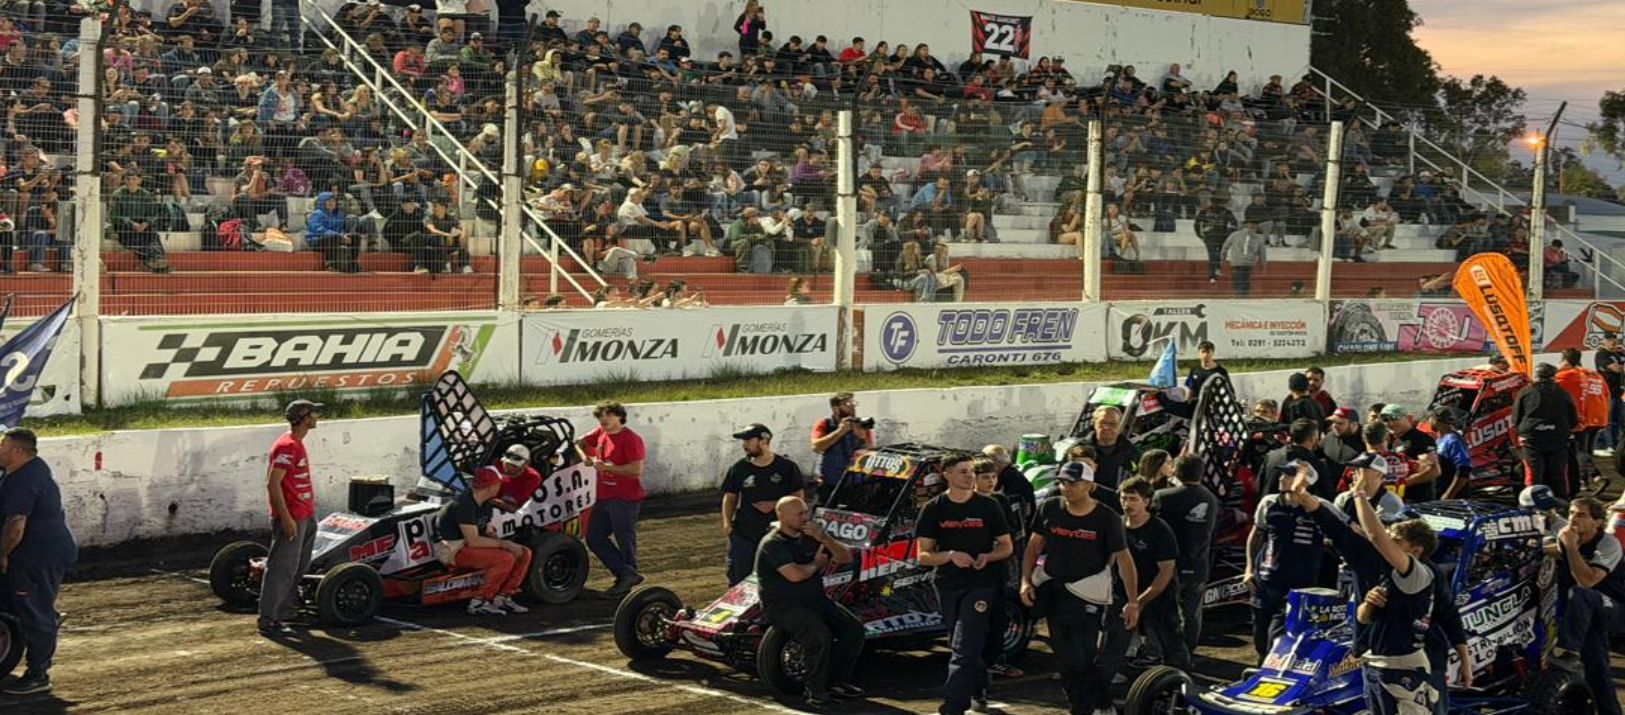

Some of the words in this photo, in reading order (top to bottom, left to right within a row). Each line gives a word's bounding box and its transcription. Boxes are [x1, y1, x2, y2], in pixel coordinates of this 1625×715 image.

[984, 23, 1015, 51] 22
[581, 327, 634, 338] GOMERÍAS
[742, 322, 786, 333] GOMERÍAS
[889, 322, 909, 353] TF
[937, 308, 1008, 344] TODO
[1008, 308, 1079, 344] FREN
[223, 331, 426, 368] BAHIA
[573, 338, 678, 362] MONZA
[735, 333, 827, 356] MONZA
[947, 353, 1026, 365] CARONTI
[1032, 352, 1062, 362] 676
[216, 372, 416, 394] REPUESTOS
[502, 491, 592, 535] MOTORES
